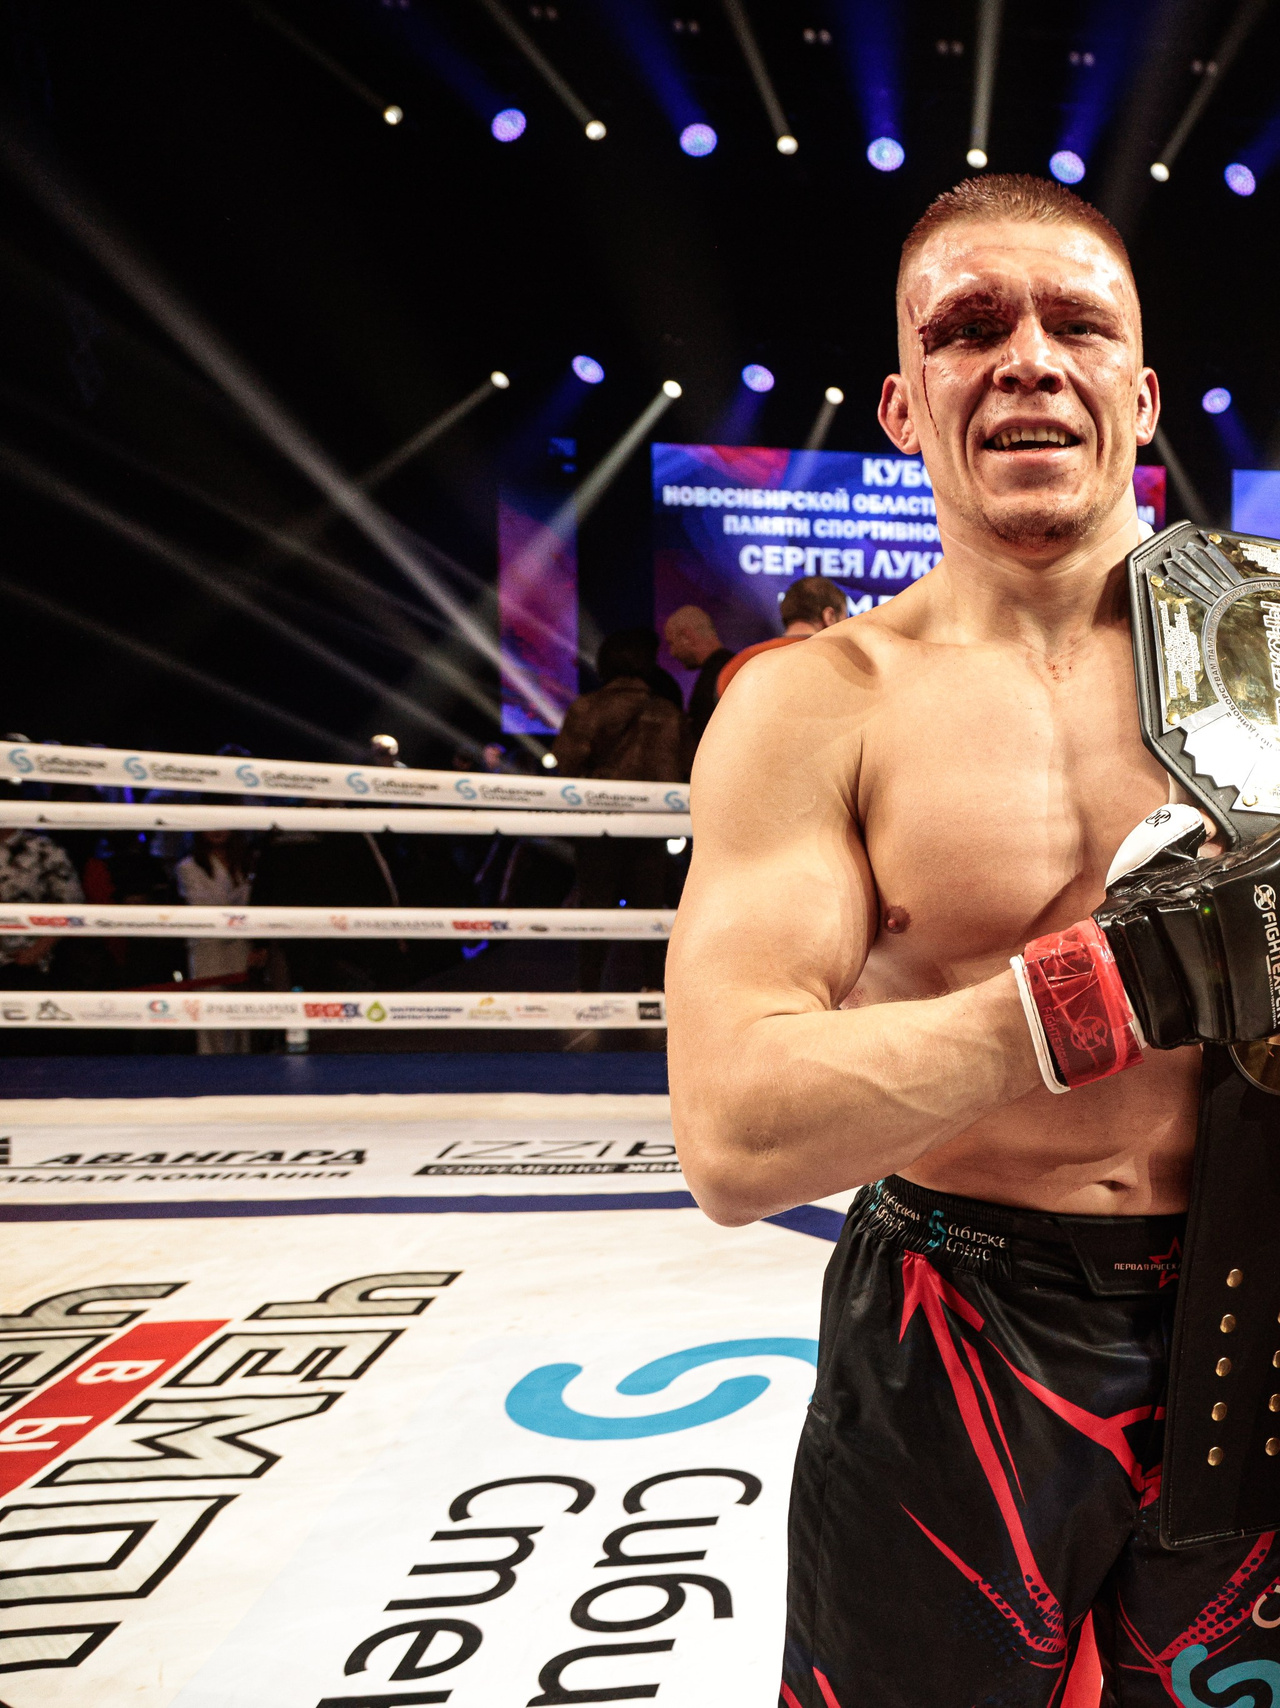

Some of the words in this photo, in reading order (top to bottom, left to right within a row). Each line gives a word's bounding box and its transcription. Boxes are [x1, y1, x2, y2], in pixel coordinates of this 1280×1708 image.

[662, 484, 849, 513] НОВОСИБИРСКОЙ
[723, 514, 811, 538] ПАМЯТИ
[739, 544, 864, 578] СЕРГЕЯ
[1209, 584, 1248, 623] СПОРТИВНОГО
[1204, 625, 1217, 660] ПАМЯТИ
[32, 1148, 369, 1166] АВАНГАРД
[134, 1171, 352, 1183] КОМПАНИЯ
[1114, 1263, 1149, 1271] ПЕРВАЯ
